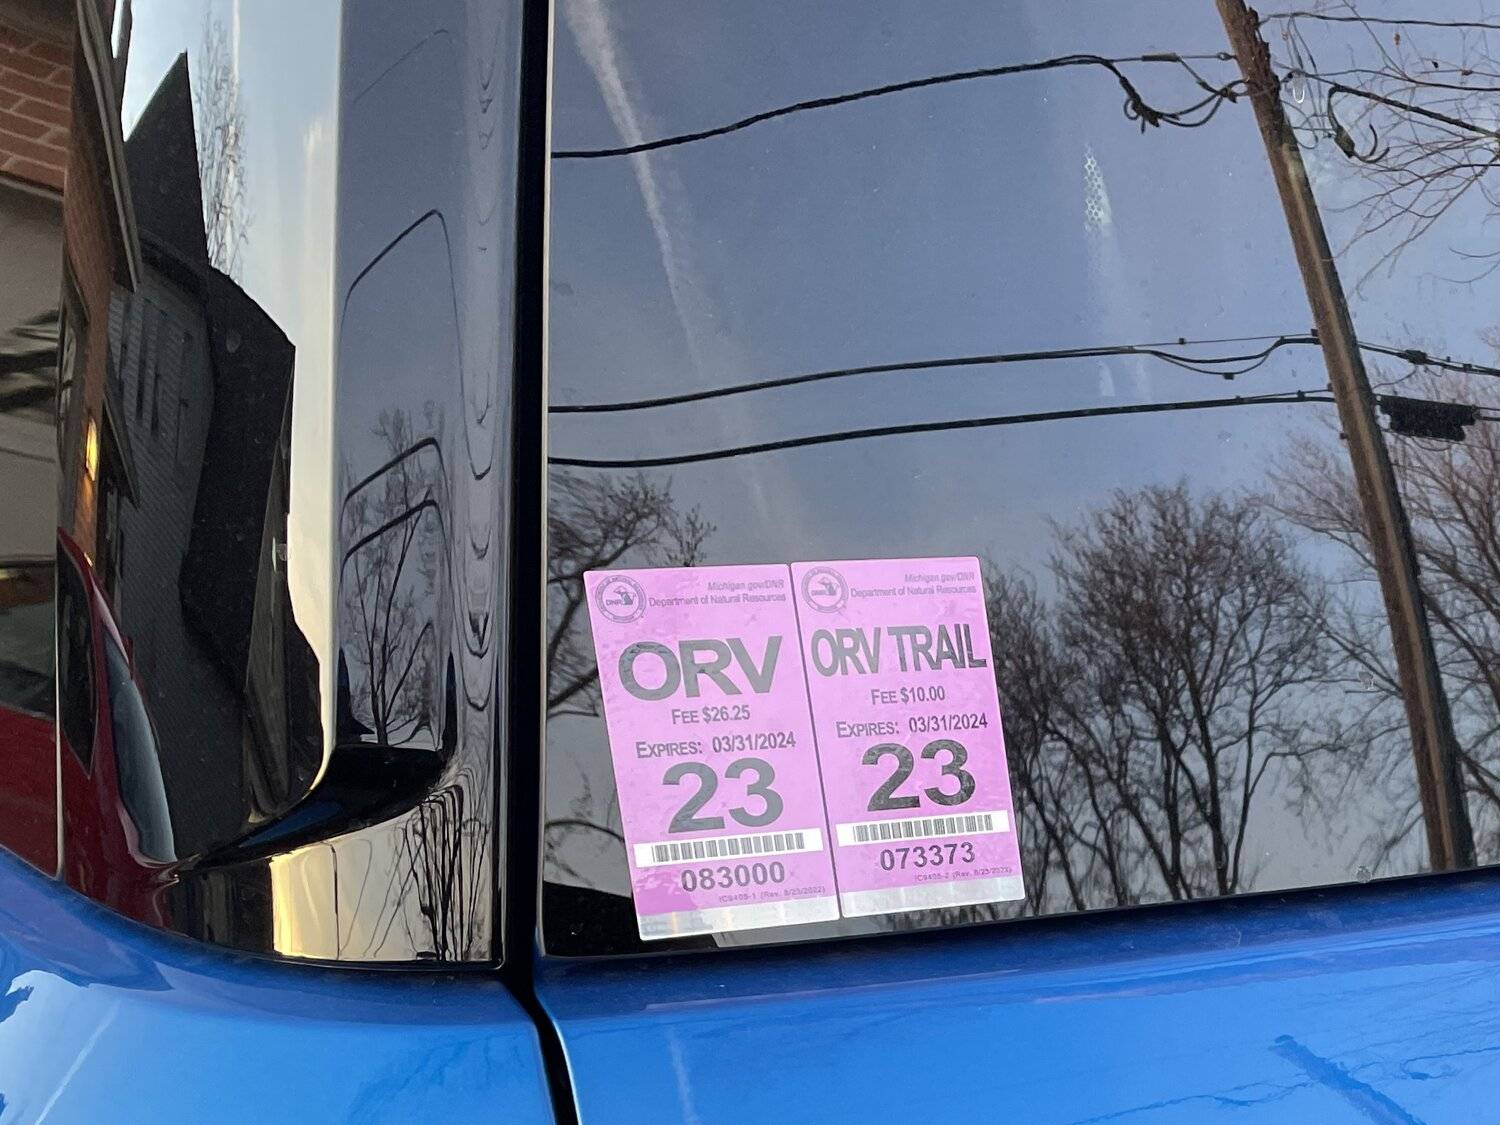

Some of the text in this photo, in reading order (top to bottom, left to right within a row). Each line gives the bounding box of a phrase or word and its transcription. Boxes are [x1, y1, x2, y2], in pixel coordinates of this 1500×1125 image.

[648, 592, 787, 607] Department of Natural Resources
[850, 584, 977, 598] Department of Natural Resources
[811, 623, 988, 677] ORV TRAIL
[618, 635, 783, 701] ORV
[900, 685, 946, 704] $10.00
[702, 704, 751, 724] $26.25
[908, 712, 988, 733] 03/31/2024
[712, 731, 797, 754] 03/31/2024
[861, 739, 976, 812] 23
[662, 757, 784, 834] 23
[879, 841, 976, 871] 073373
[680, 861, 785, 892] 083000
